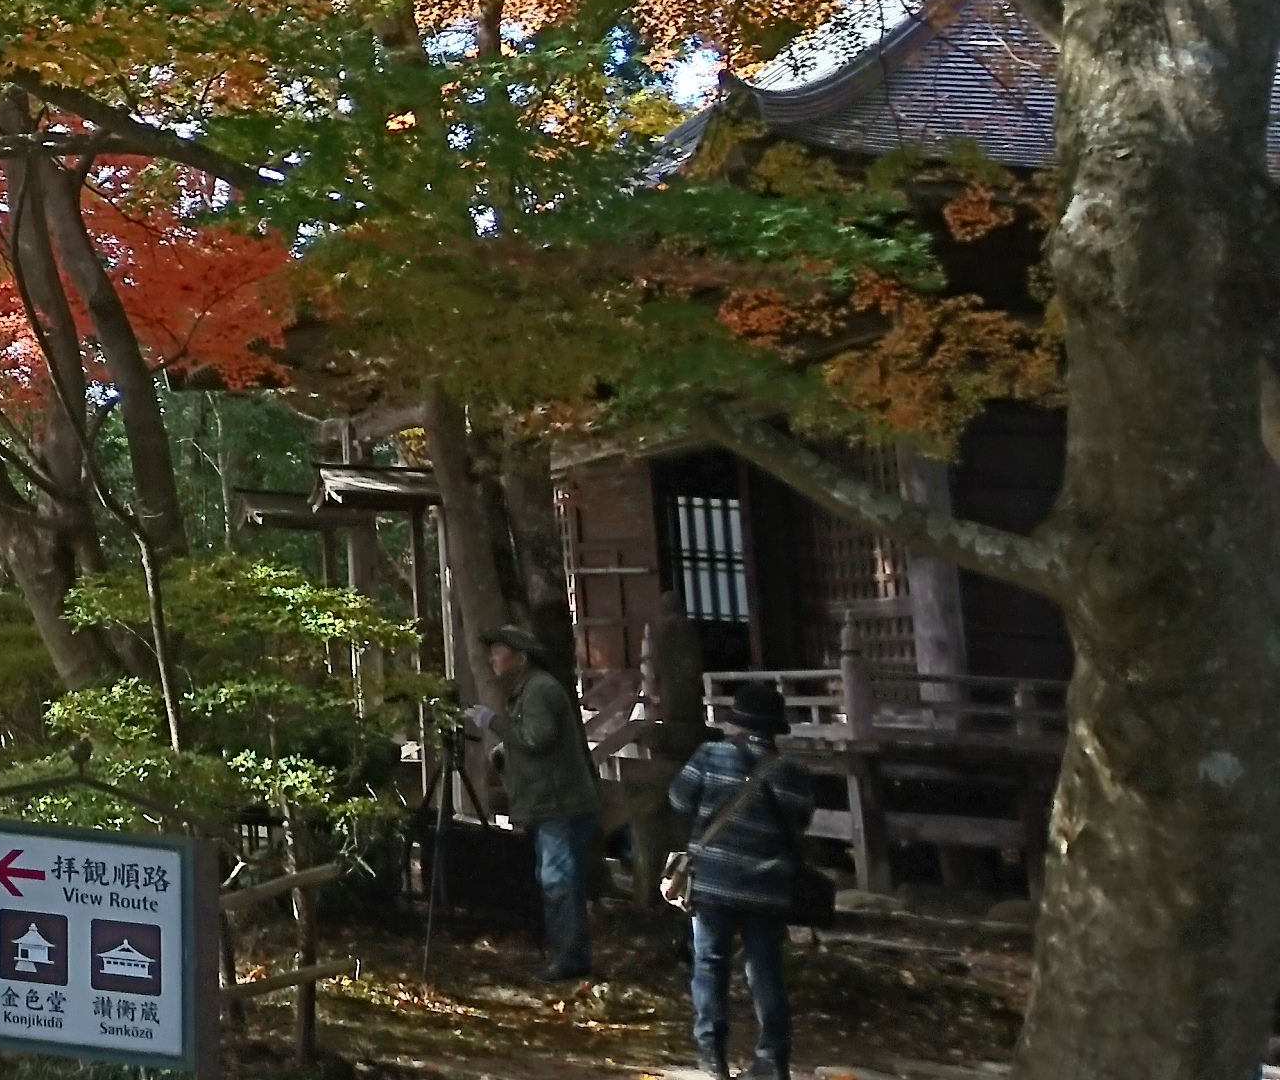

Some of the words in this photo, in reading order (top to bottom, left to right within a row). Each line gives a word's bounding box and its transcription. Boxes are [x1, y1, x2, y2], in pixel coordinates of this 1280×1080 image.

[50, 855, 171, 893] 拝観順路
[62, 886, 103, 907] View
[109, 892, 159, 913] Route
[1, 985, 67, 1014] 金色堂
